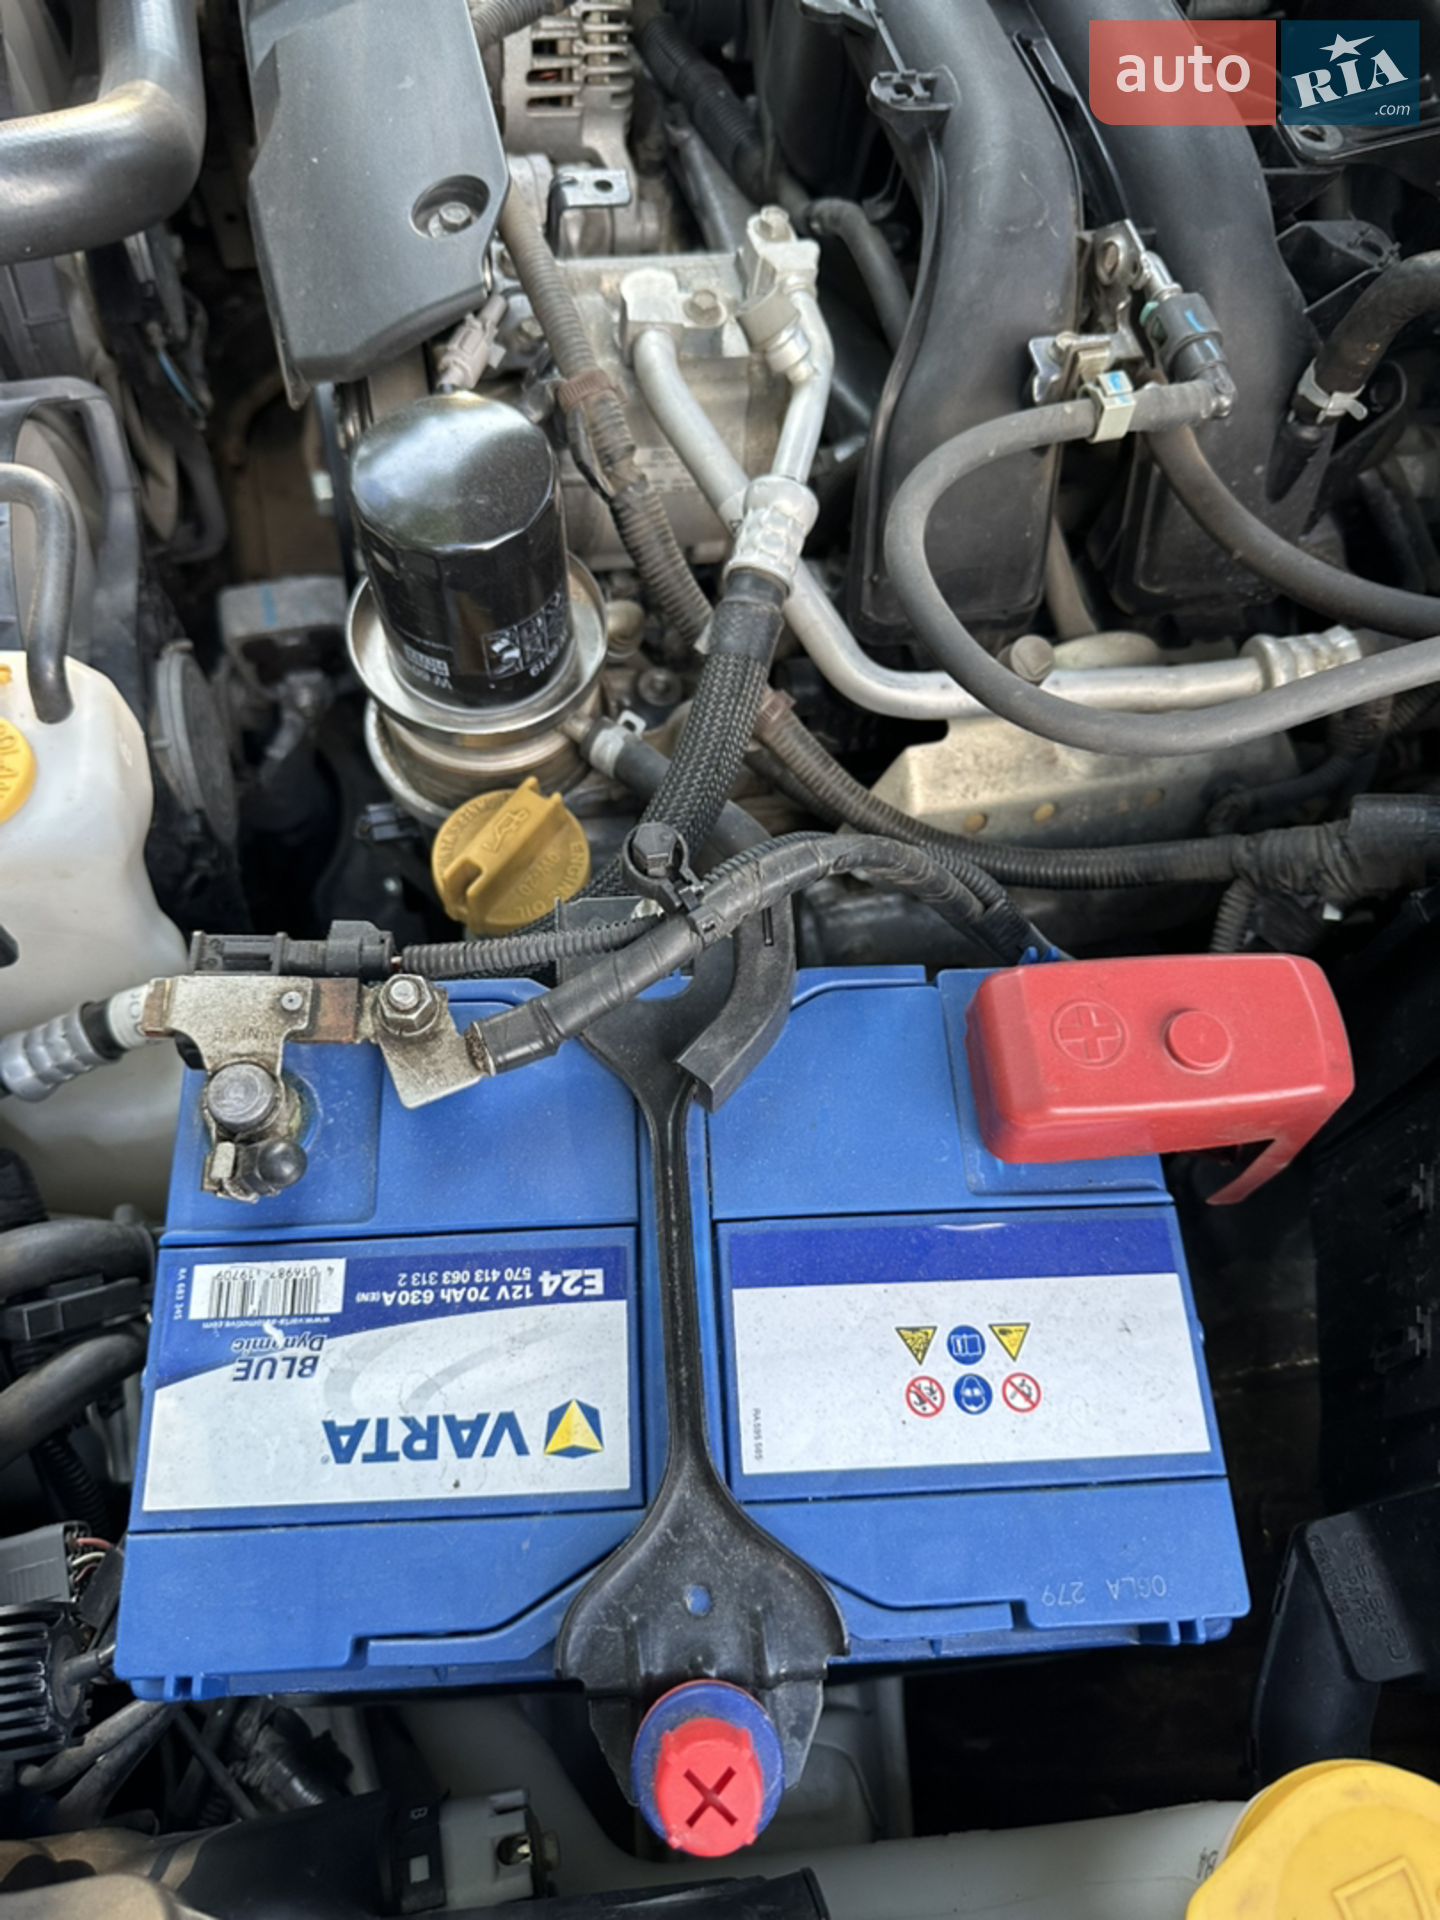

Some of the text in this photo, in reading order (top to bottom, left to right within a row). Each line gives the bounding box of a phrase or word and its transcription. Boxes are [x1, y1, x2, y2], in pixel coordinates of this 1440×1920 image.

[514, 901, 548, 919] OIL
[326, 1265, 335, 1277] 4
[397, 1266, 532, 1287] 570 413 063 313 2
[495, 1284, 534, 1300] 12V
[538, 1268, 605, 1297] E24
[440, 1286, 490, 1302] 70Ah
[232, 1355, 320, 1382] BLUE
[322, 1412, 529, 1465] VARTA
[1041, 1581, 1086, 1607] 279
